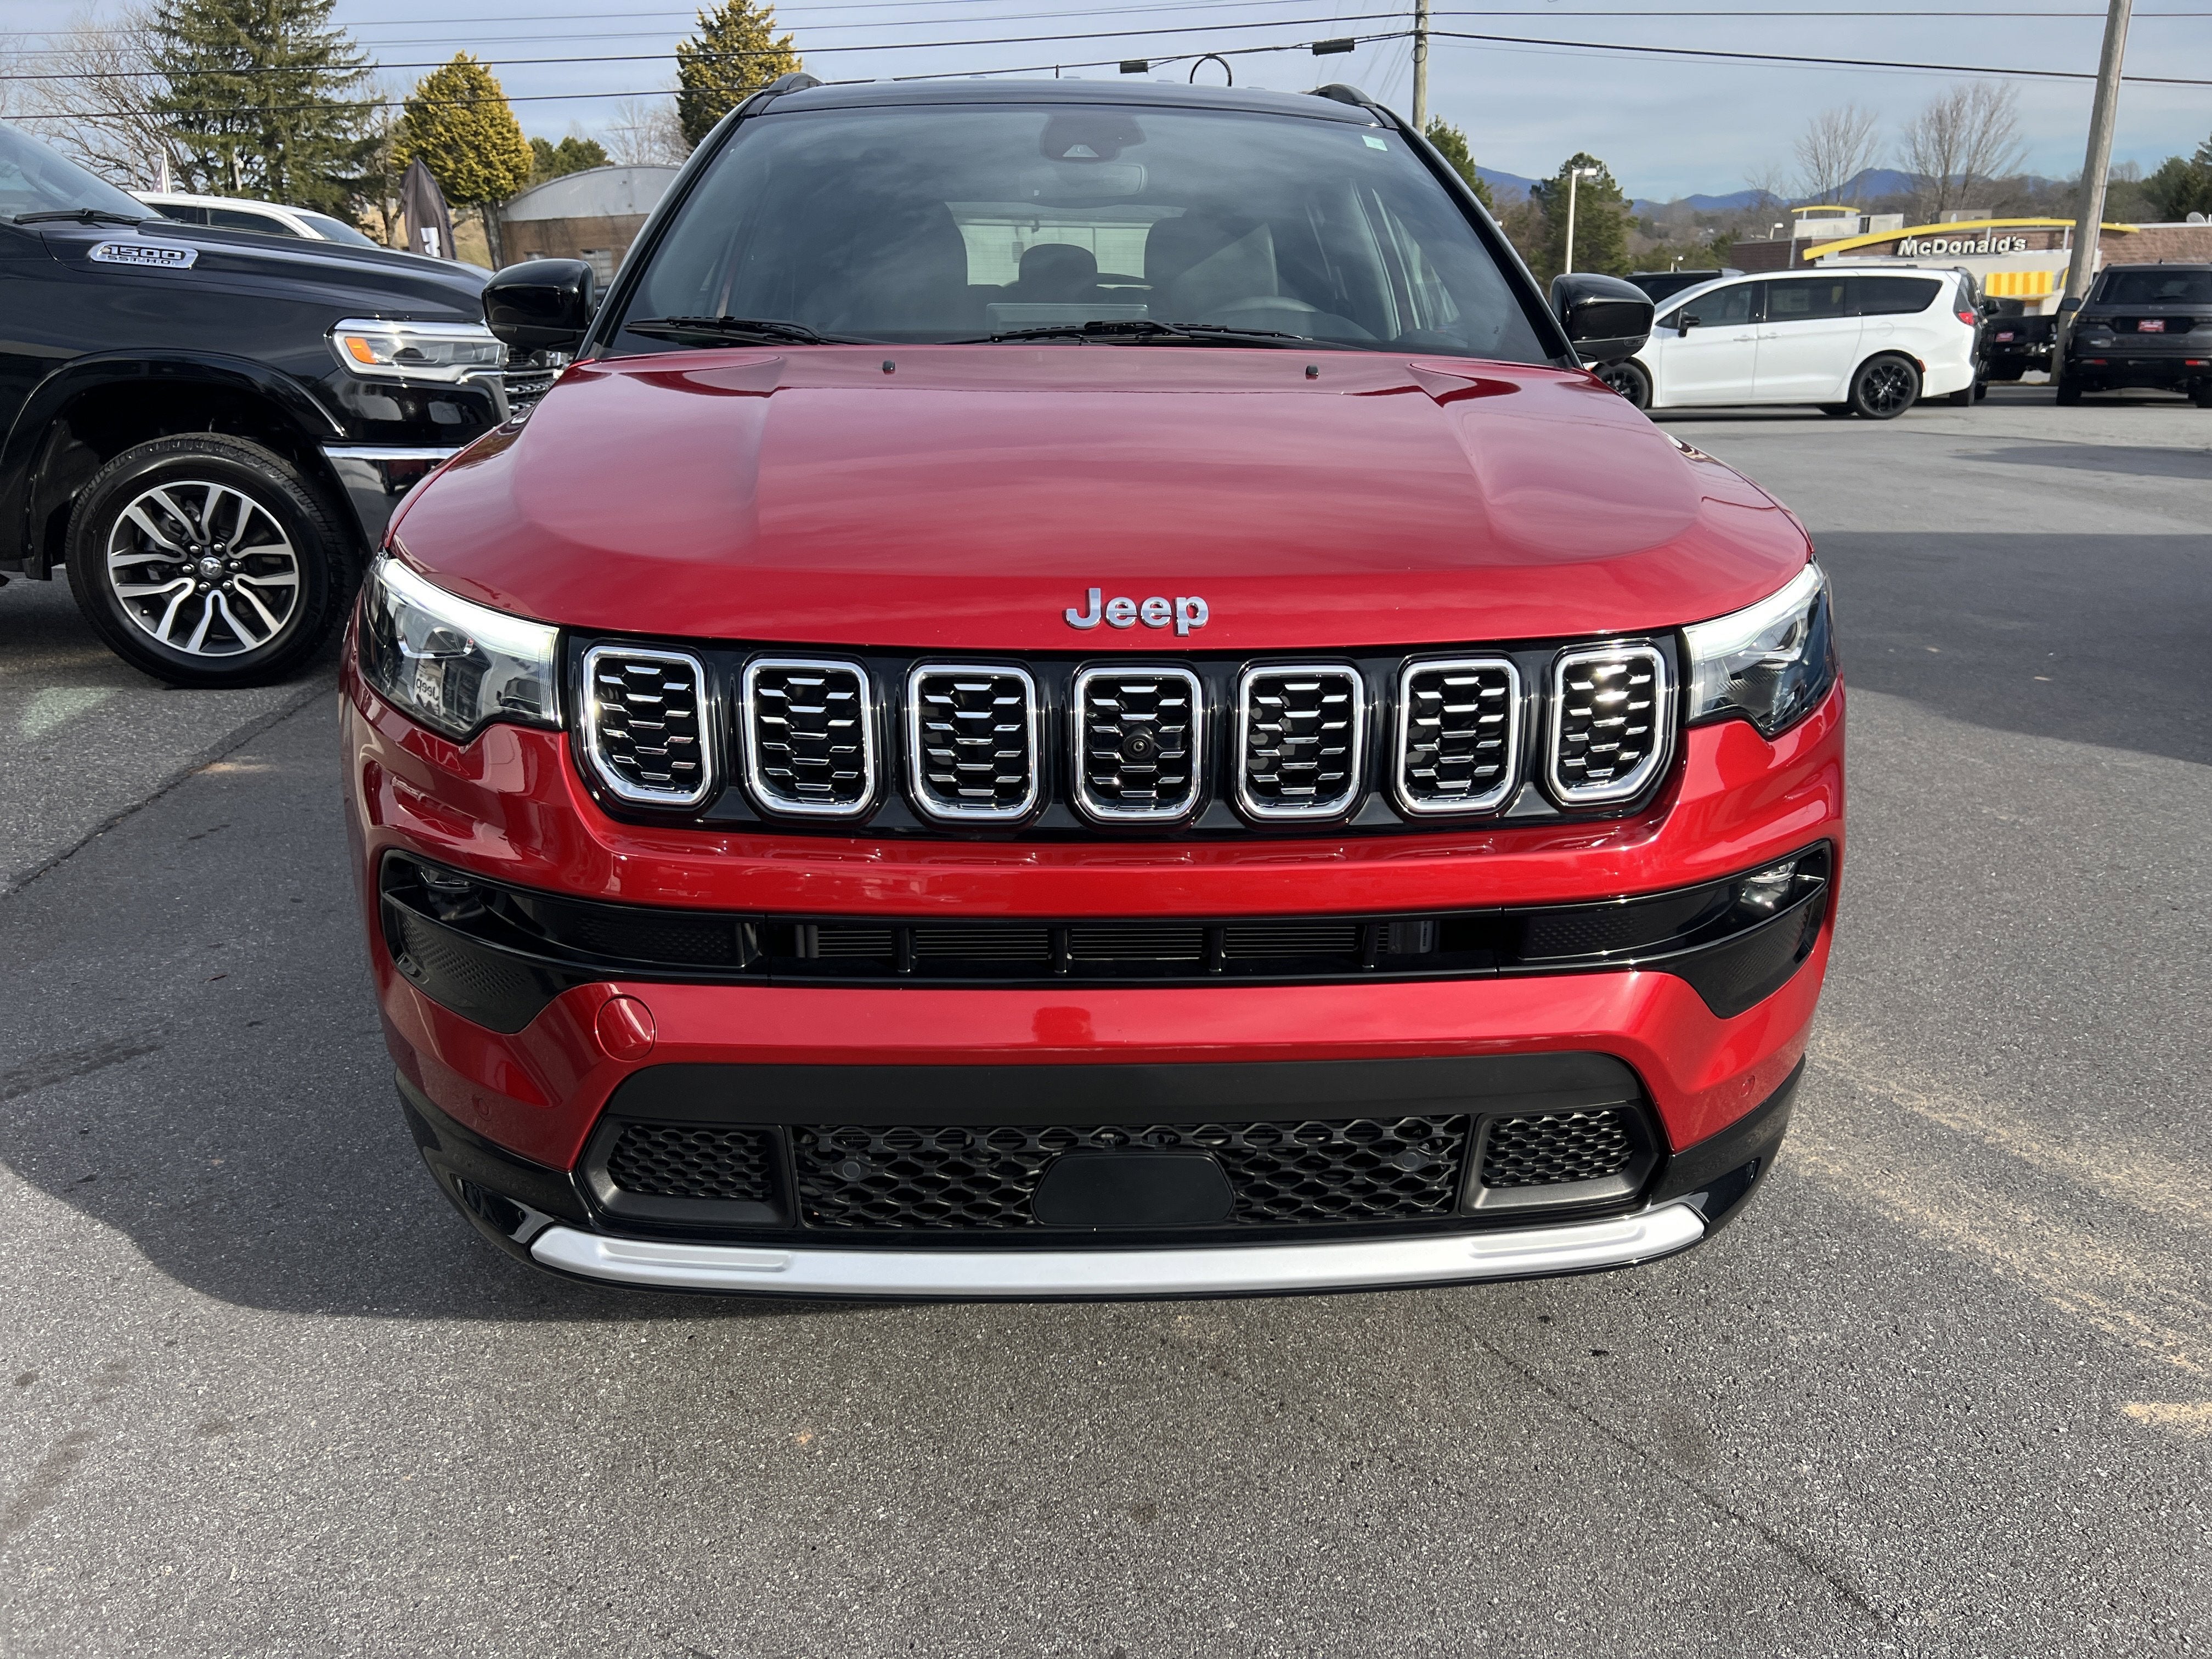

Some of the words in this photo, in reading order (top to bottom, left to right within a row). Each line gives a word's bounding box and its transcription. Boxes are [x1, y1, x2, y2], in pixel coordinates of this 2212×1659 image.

[109, 246, 182, 260] 1500
[1897, 236, 2027, 257] McDonald's
[1065, 587, 1210, 637] Jeep
